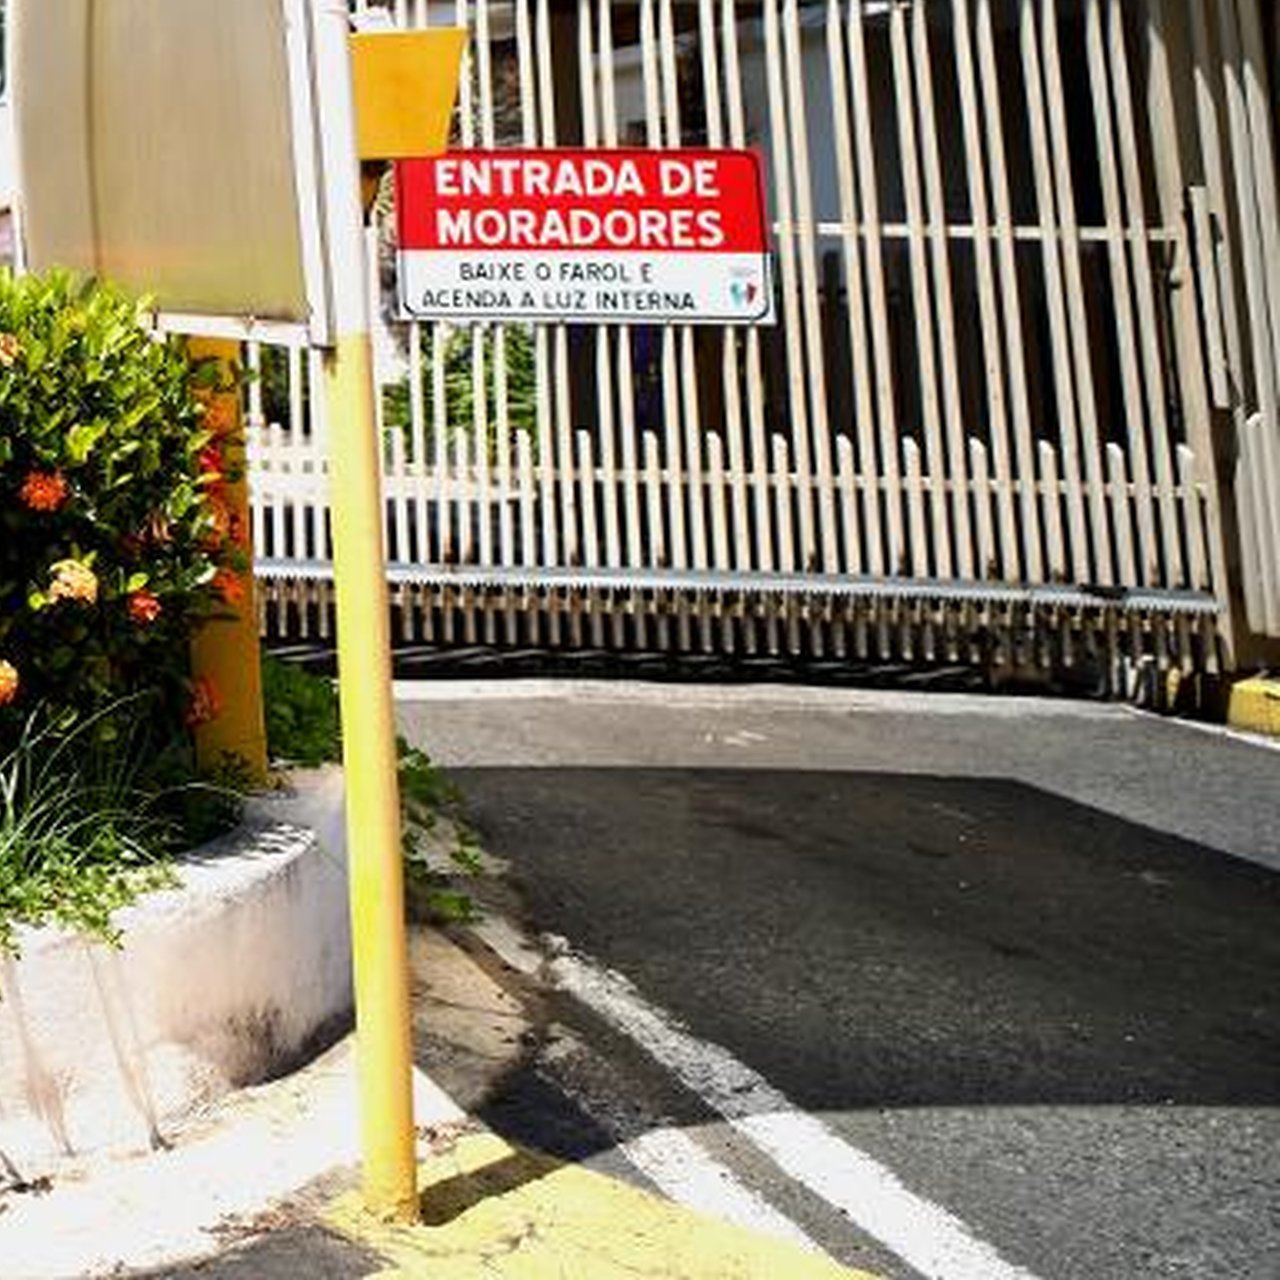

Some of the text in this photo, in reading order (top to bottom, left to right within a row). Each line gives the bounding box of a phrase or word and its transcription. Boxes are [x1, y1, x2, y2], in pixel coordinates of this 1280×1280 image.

[435, 159, 719, 197] ENTRADA DE
[438, 209, 724, 247] MORADORES
[459, 262, 653, 283] BAIXE O FAROL E
[421, 289, 697, 311] ACENDA A LUZ INTERNA
